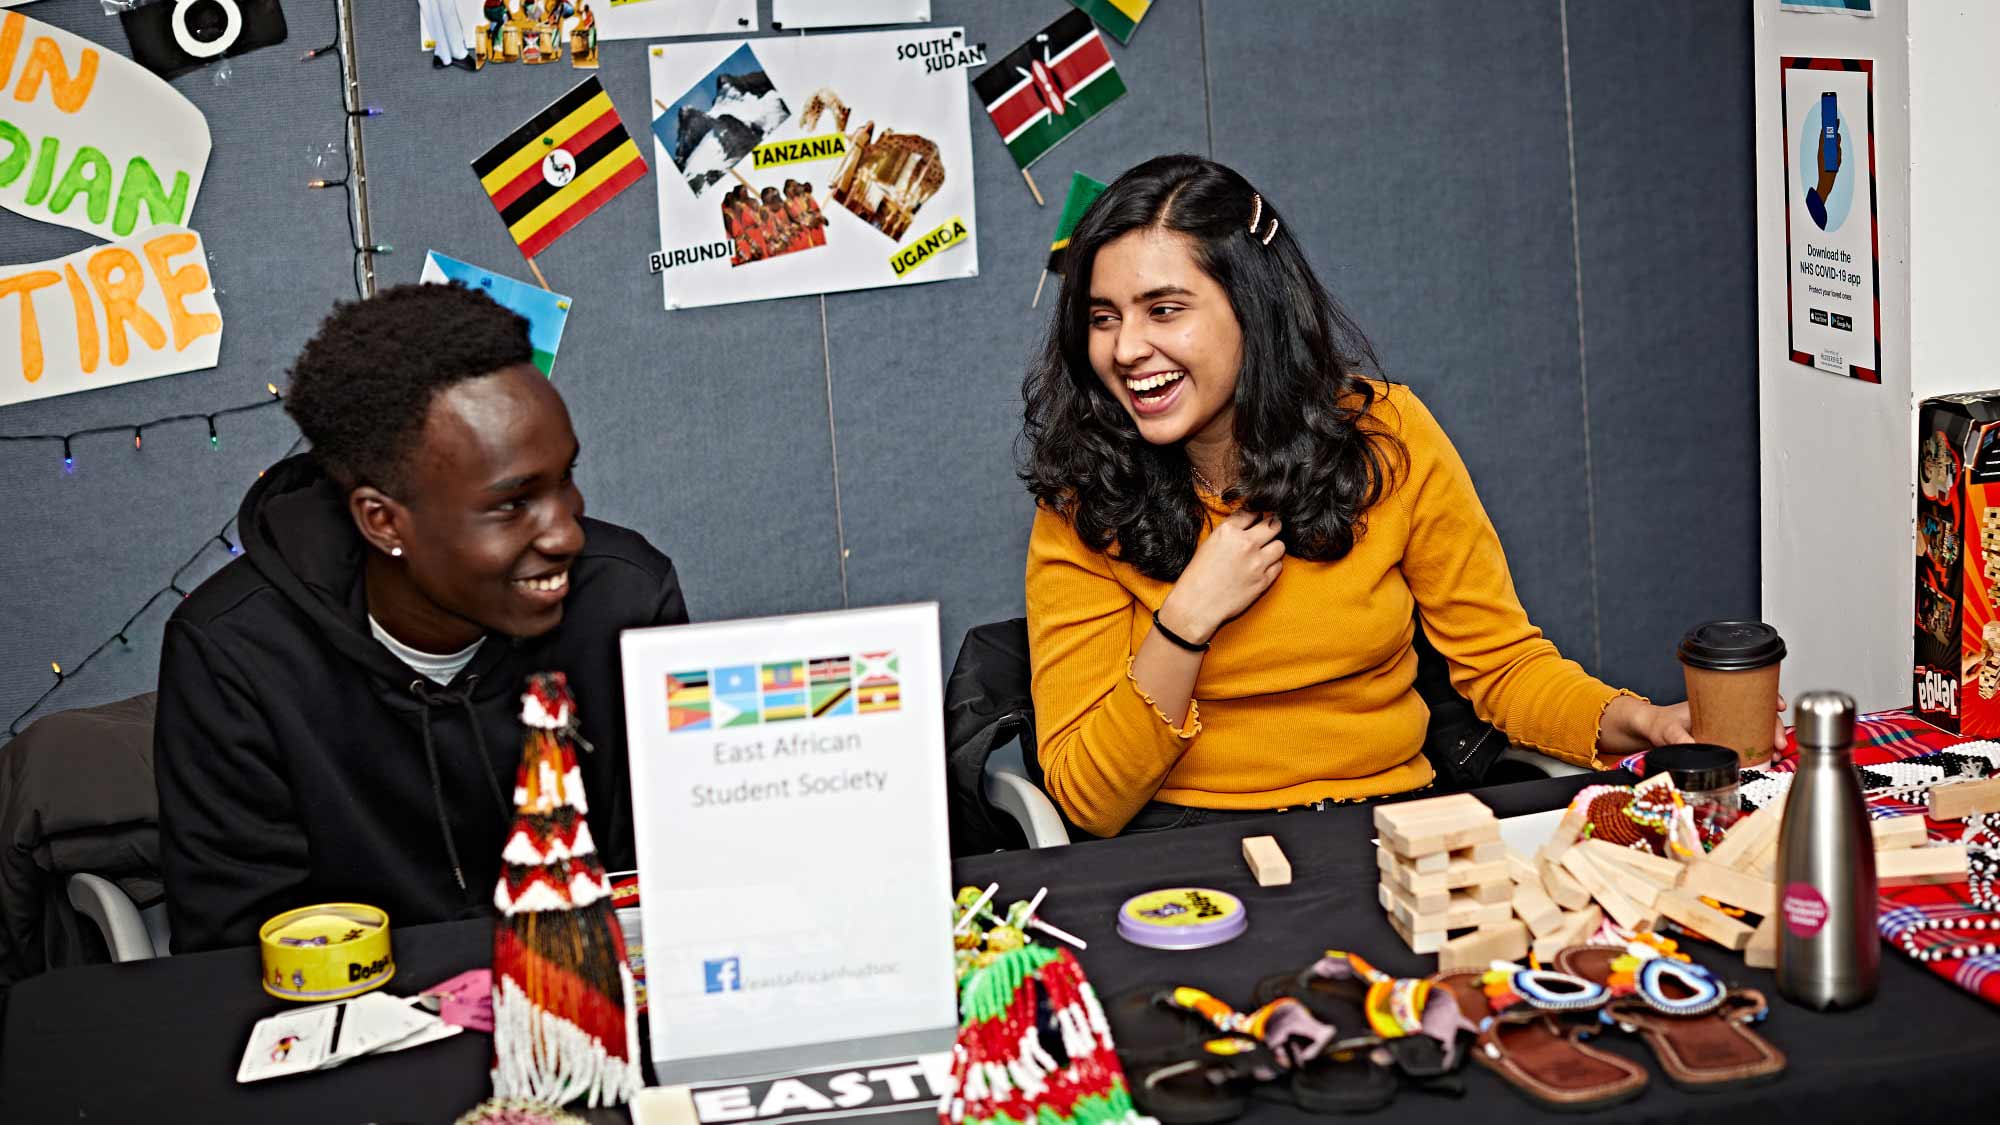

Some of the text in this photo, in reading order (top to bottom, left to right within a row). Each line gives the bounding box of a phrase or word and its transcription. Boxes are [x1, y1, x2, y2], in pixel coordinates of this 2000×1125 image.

[897, 38, 953, 60] SOUTH
[925, 44, 984, 73] SUDAN
[752, 138, 845, 166] TANZANIA
[651, 240, 733, 271] BURUNDI
[891, 221, 967, 275] UGANDA
[1807, 244, 1851, 263] Download the
[1800, 261, 1861, 287] NHS COVID-19 app
[0, 233, 221, 383] TIRE
[1918, 670, 1958, 716] Jenga
[713, 732, 862, 766] East African
[691, 770, 888, 808] Student Society
[693, 1063, 925, 1124] EAST
